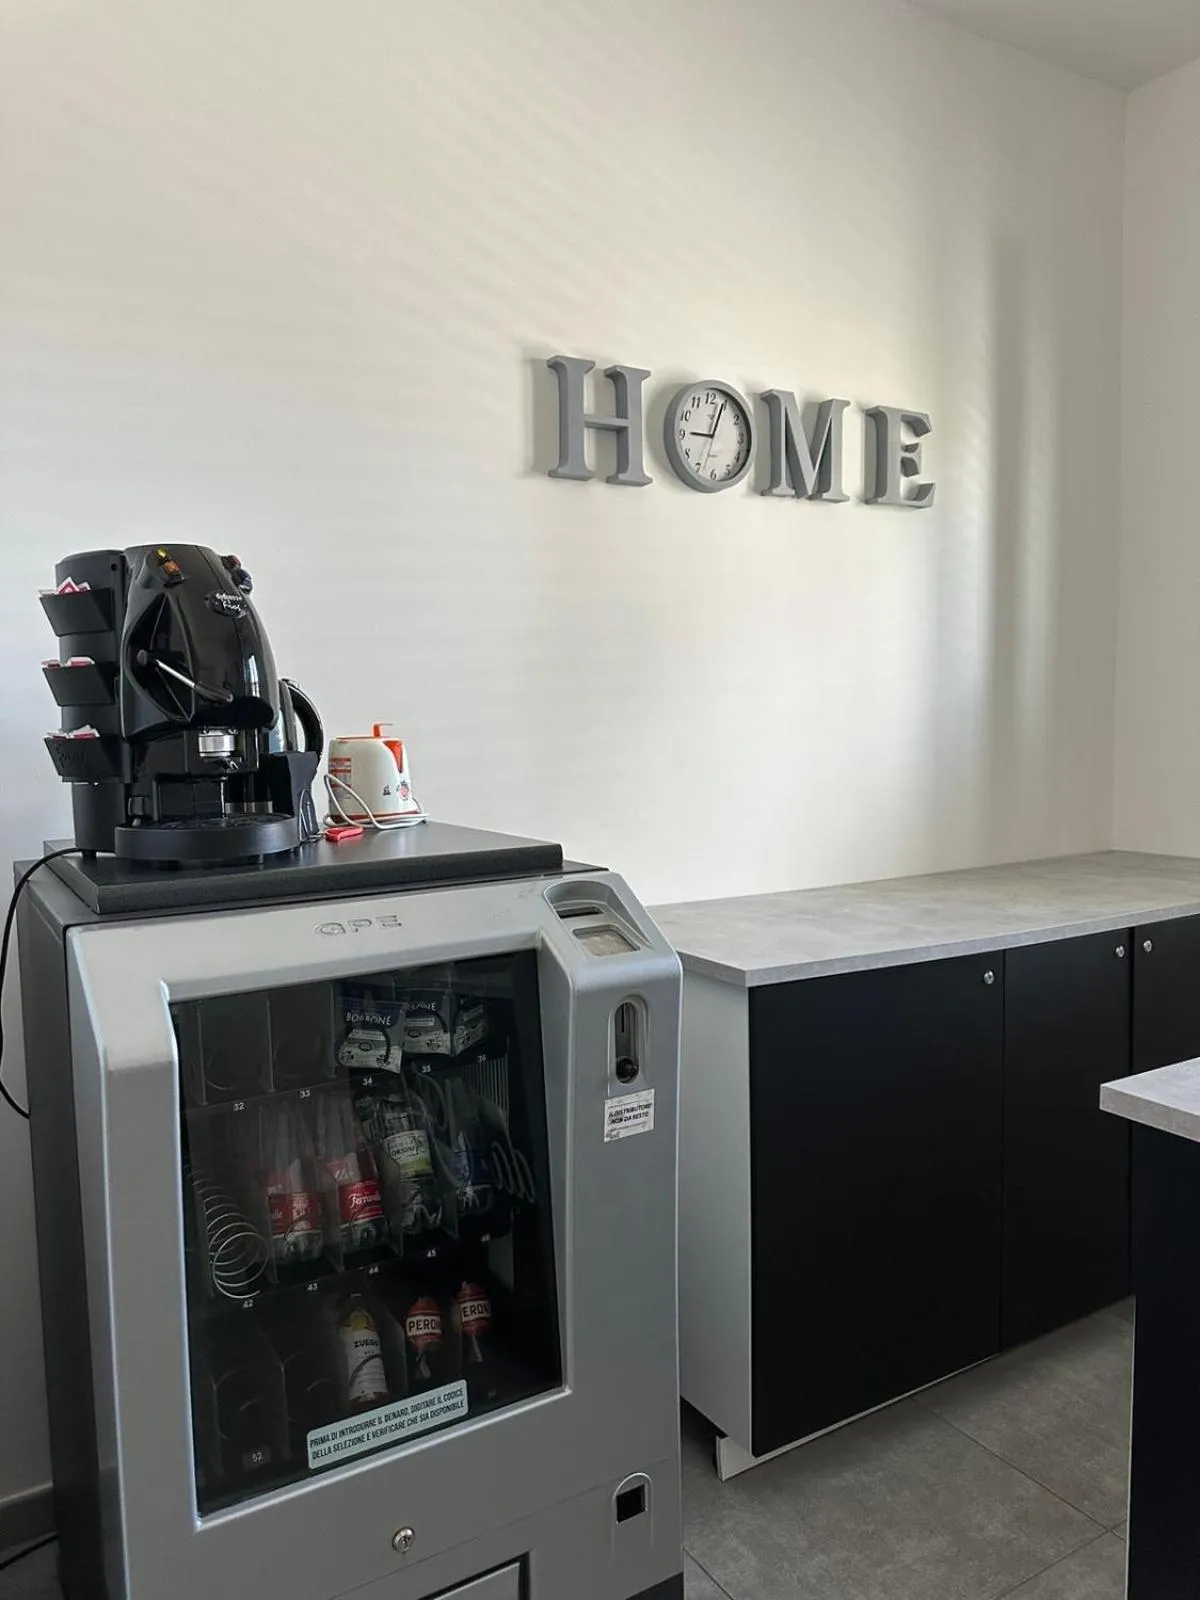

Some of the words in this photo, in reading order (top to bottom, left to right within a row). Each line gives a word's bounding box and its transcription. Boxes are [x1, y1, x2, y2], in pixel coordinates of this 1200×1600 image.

[691, 396, 701, 408] 11
[705, 392, 717, 405] 12
[680, 409, 691, 422] 10
[733, 413, 740, 425] 2
[679, 428, 686, 440] 9
[684, 447, 691, 459] 8
[695, 462, 702, 473] 7
[710, 468, 717, 480] 6
[310, 1434, 330, 1448] PRIMA
[339, 1418, 377, 1438] INTRODURRE
[443, 1388, 463, 1401] CODICE
[312, 1446, 332, 1460] DELLA
[333, 1434, 366, 1453] SELEZIONE
[372, 1420, 405, 1439] VERIFICARE
[407, 1415, 419, 1427] CHE
[420, 1412, 429, 1422] SIA
[430, 1400, 464, 1418] DISPONIBILE
